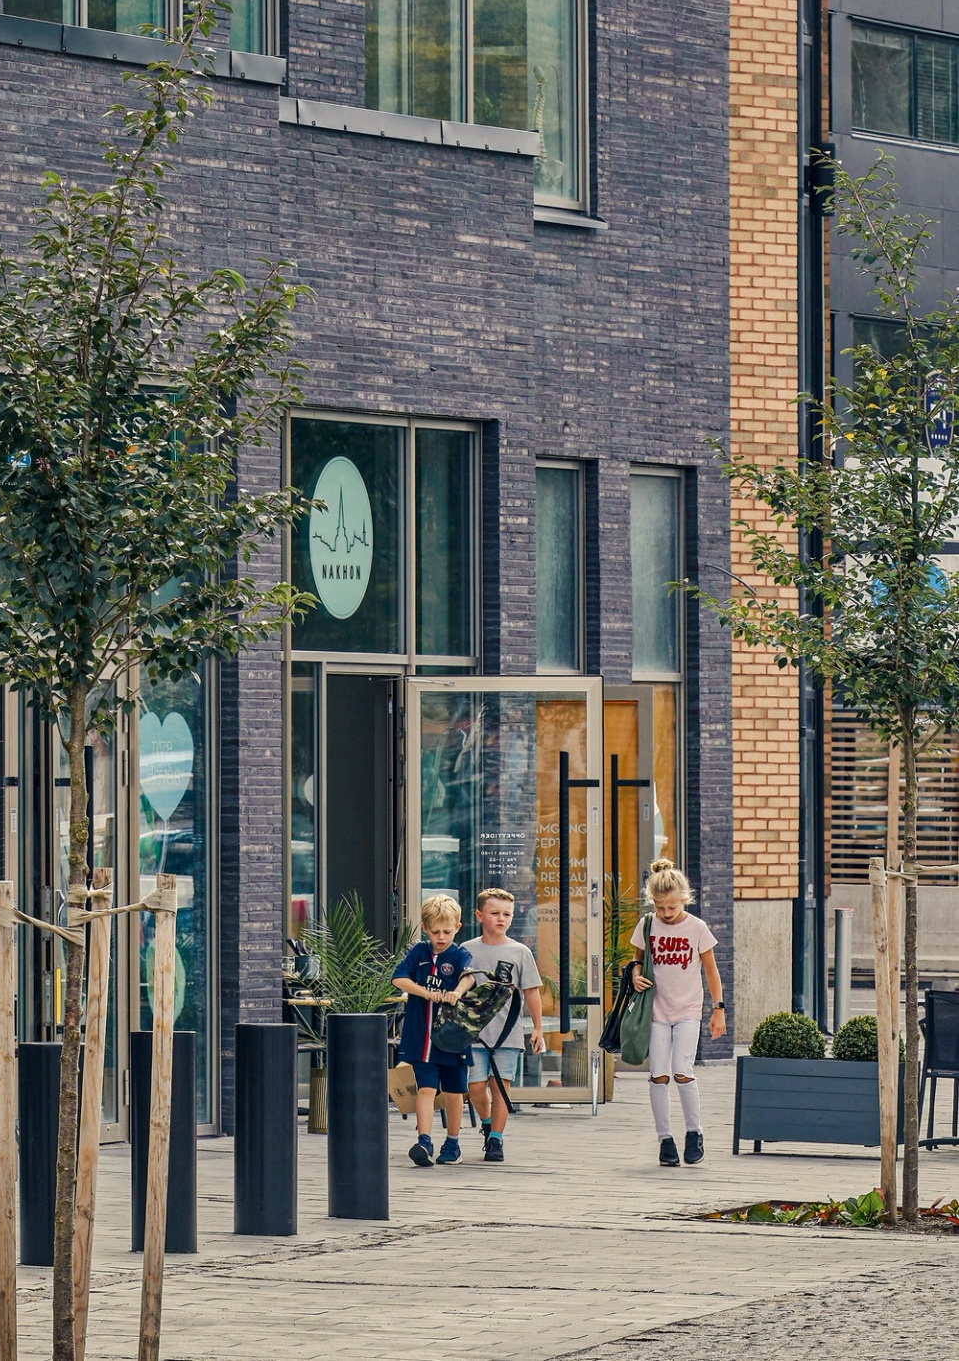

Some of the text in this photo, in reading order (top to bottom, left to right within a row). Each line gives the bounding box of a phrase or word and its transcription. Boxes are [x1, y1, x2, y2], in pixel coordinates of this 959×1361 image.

[322, 564, 361, 580] NAKHON
[658, 936, 690, 953] SUIS
[426, 975, 442, 988] Fly
